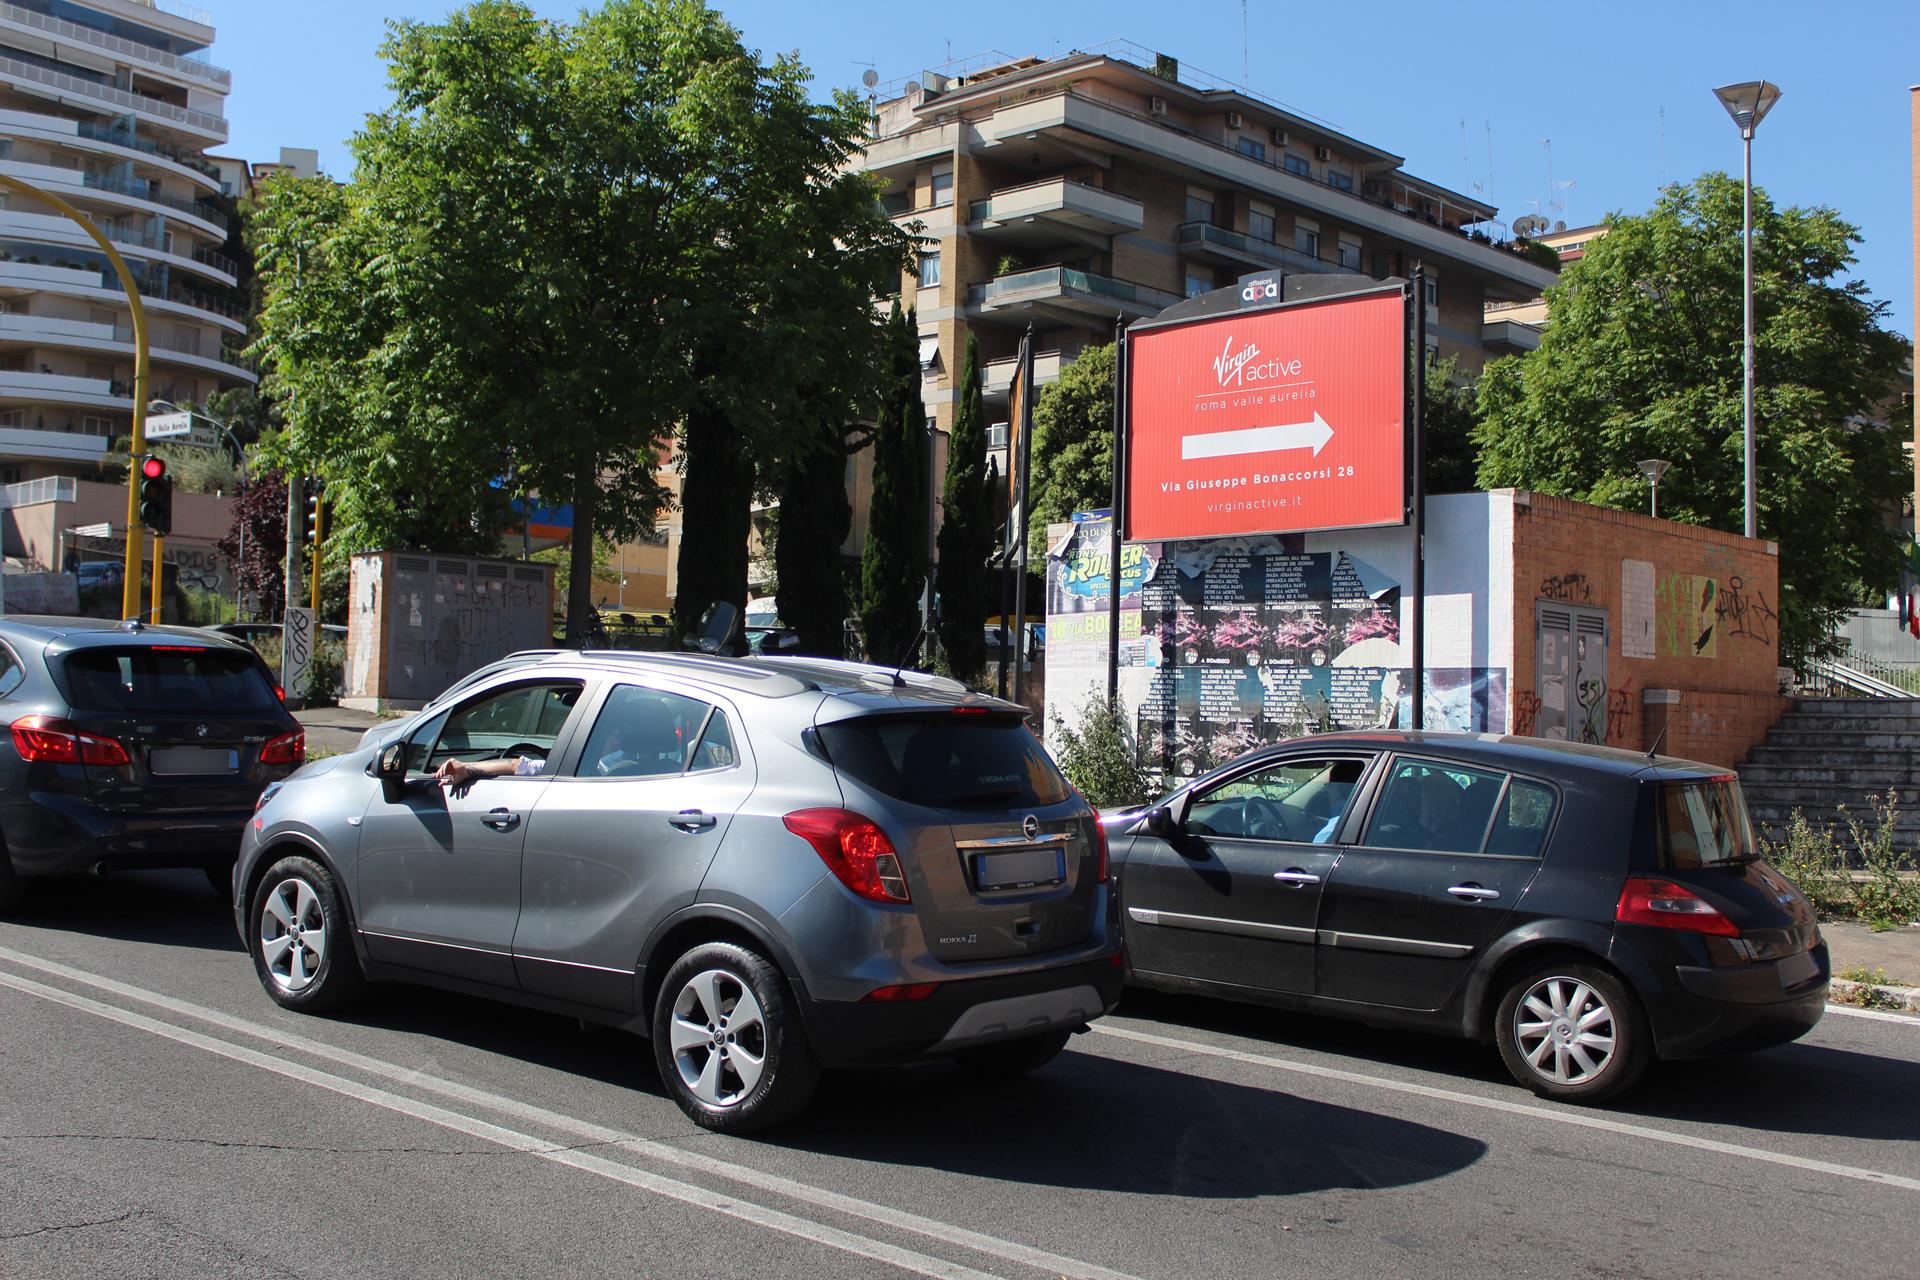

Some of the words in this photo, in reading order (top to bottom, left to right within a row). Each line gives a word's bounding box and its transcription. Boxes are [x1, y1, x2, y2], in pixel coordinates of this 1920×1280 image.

[1213, 335, 1260, 386] Virgin
[1246, 358, 1302, 381] active
[1195, 400, 1226, 412] roma
[1233, 396, 1264, 407] valle
[1269, 389, 1316, 403] aurelia
[1161, 482, 1180, 492] Via
[1186, 478, 1247, 490] Giuseppe
[1254, 468, 1331, 484] Bonaccorsi
[1338, 466, 1354, 477] 28
[1207, 496, 1302, 513] virginactive.it
